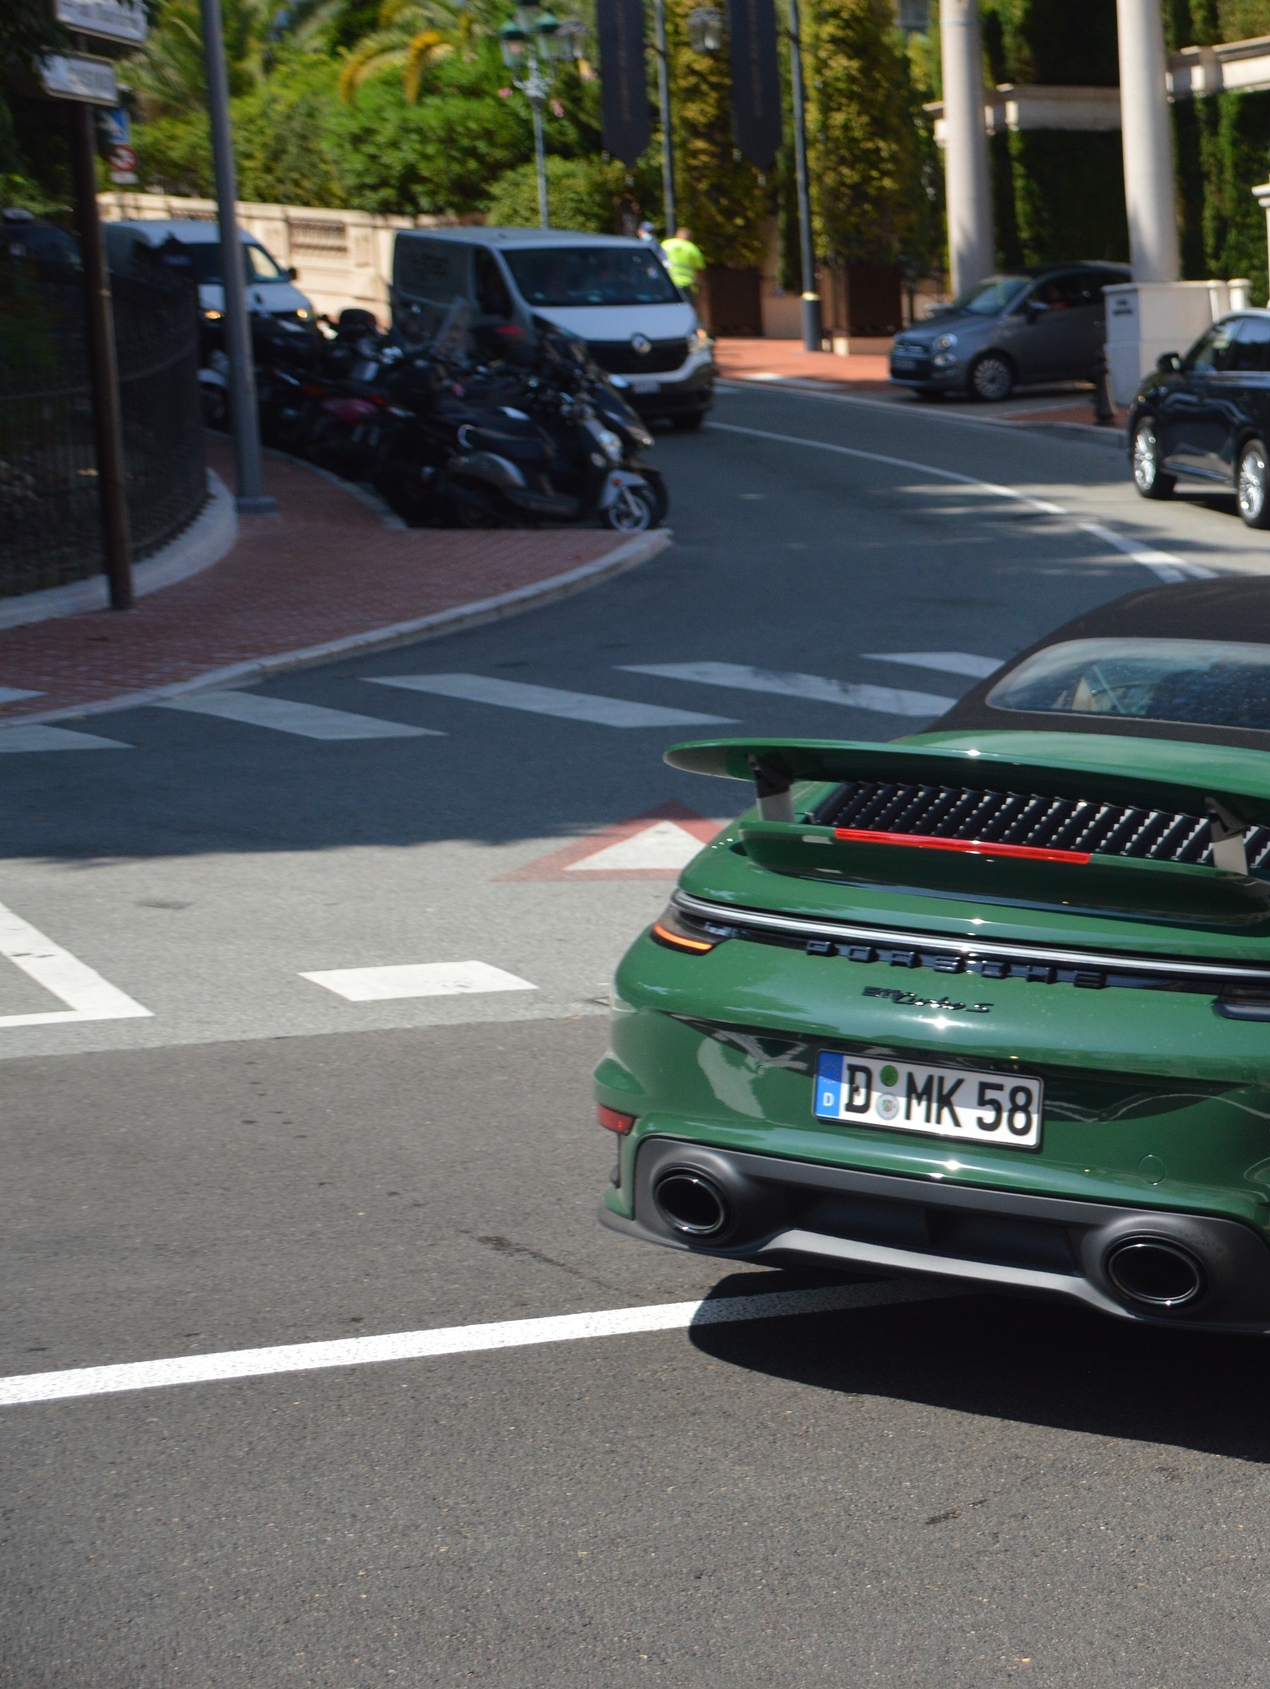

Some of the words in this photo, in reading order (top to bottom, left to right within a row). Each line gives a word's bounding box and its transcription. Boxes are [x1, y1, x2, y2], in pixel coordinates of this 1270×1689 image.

[806, 941, 1106, 989] PORSCHE
[845, 1063, 873, 1114] D
[904, 1071, 965, 1128] MK
[976, 1080, 1033, 1136] 58
